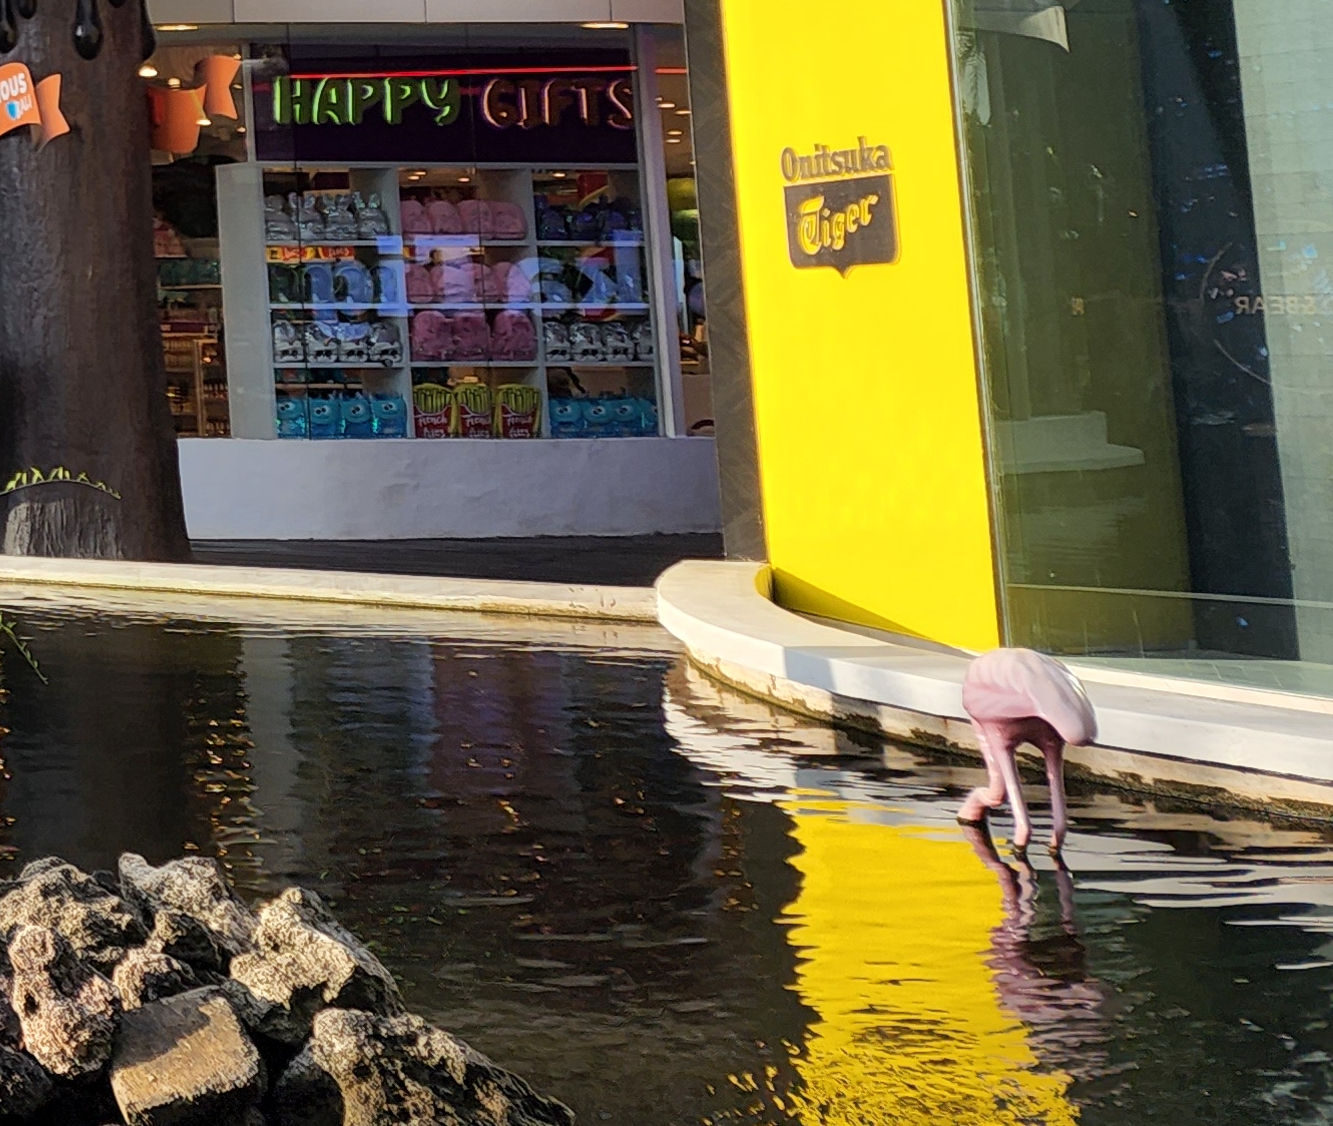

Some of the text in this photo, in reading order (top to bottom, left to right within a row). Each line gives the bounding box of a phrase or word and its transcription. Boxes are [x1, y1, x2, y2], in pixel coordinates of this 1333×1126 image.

[272, 76, 632, 129] HAPPY GIFTS
[780, 136, 894, 183] Onitsuka
[798, 193, 879, 255] Tiger
